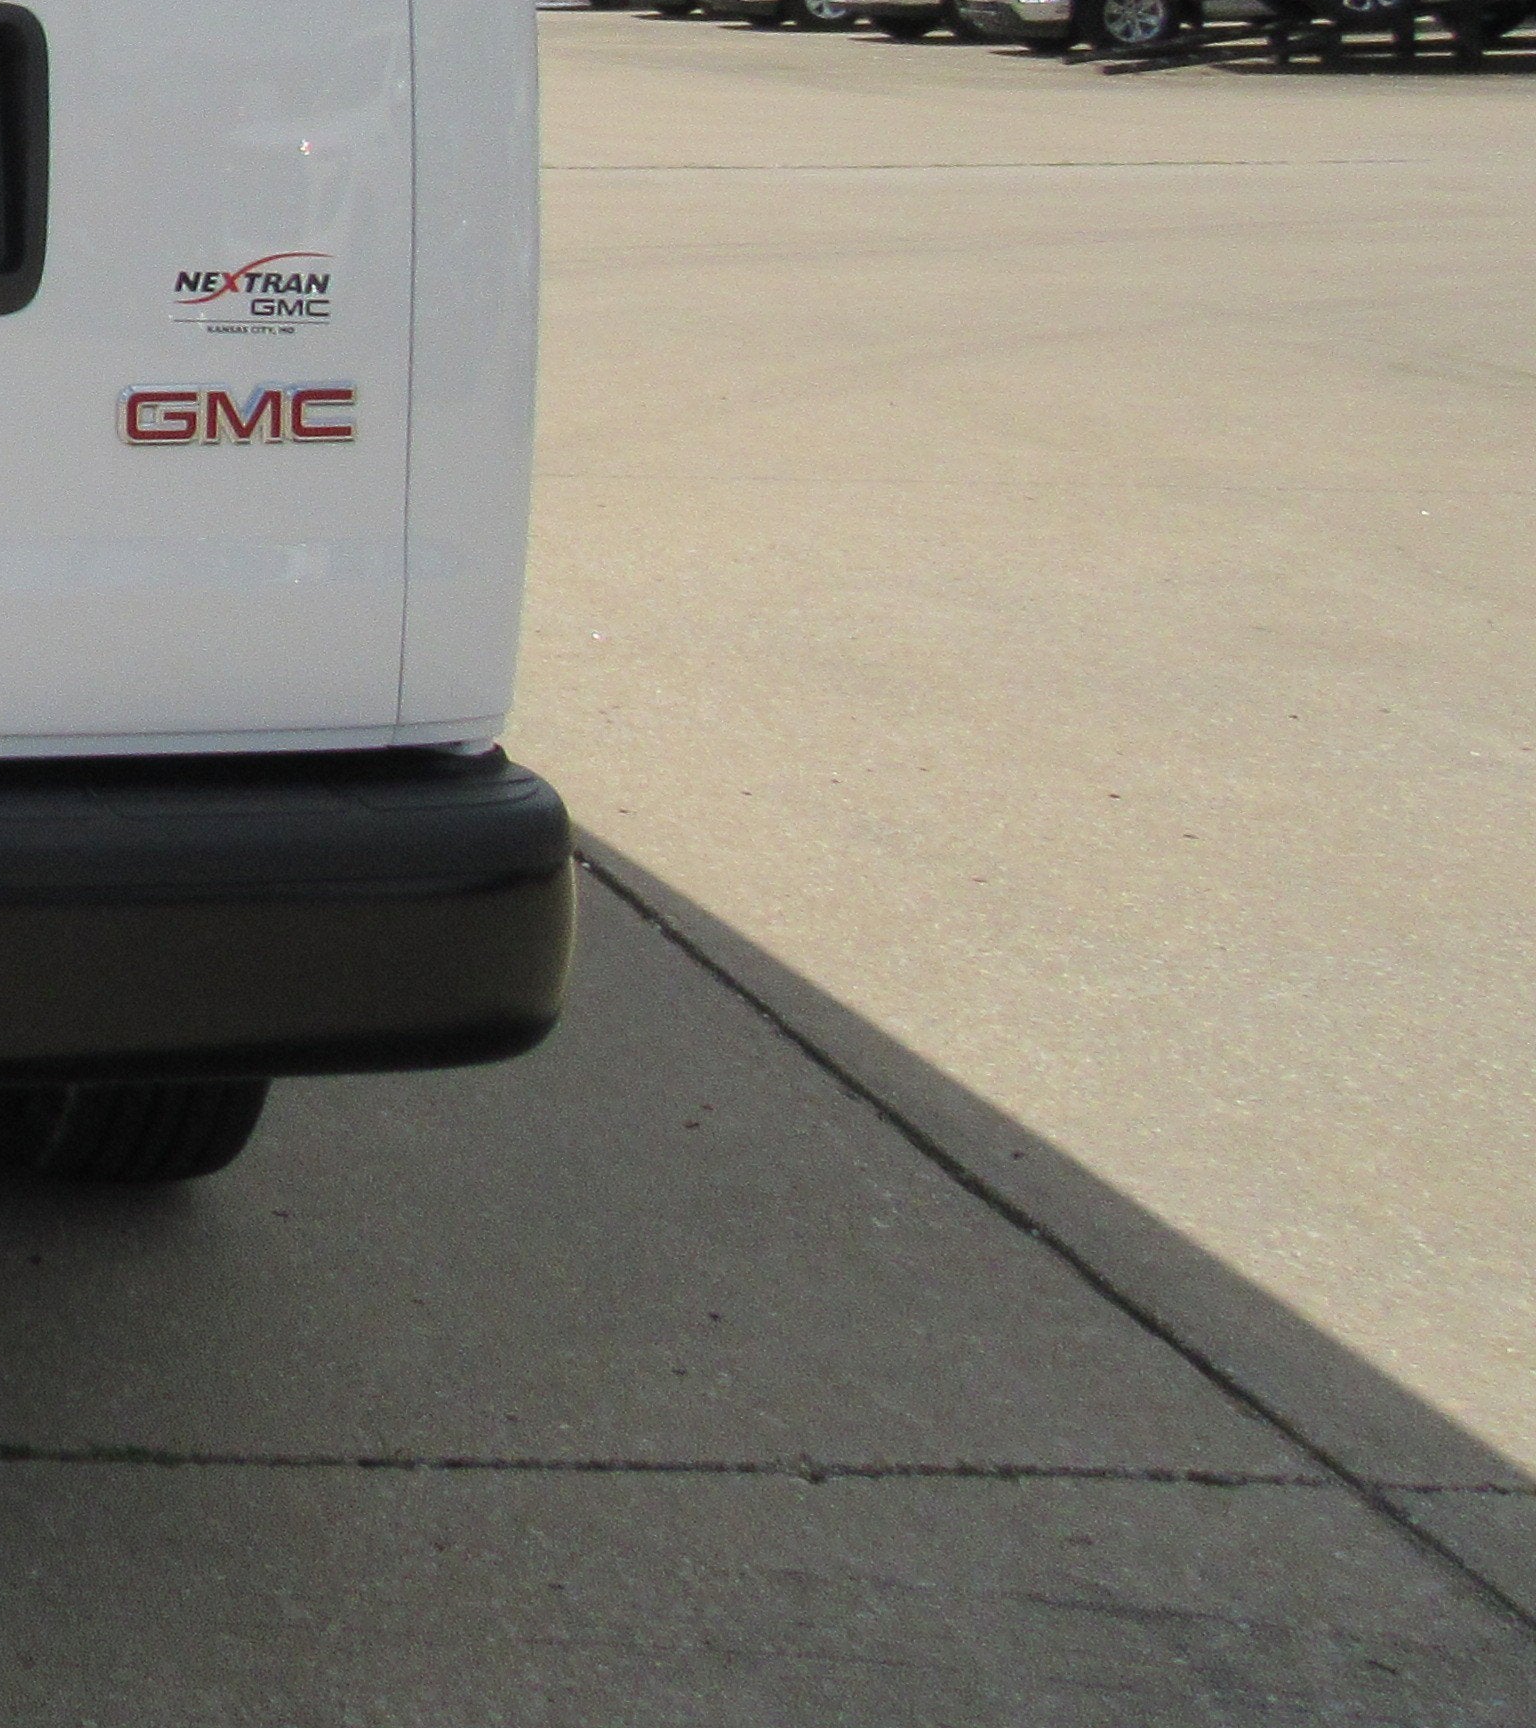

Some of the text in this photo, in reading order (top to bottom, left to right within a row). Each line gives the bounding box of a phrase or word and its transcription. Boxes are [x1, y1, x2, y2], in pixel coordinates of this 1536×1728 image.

[175, 271, 330, 294] NEXTRAN
[250, 298, 330, 317] GMC
[118, 381, 356, 445] GMC
